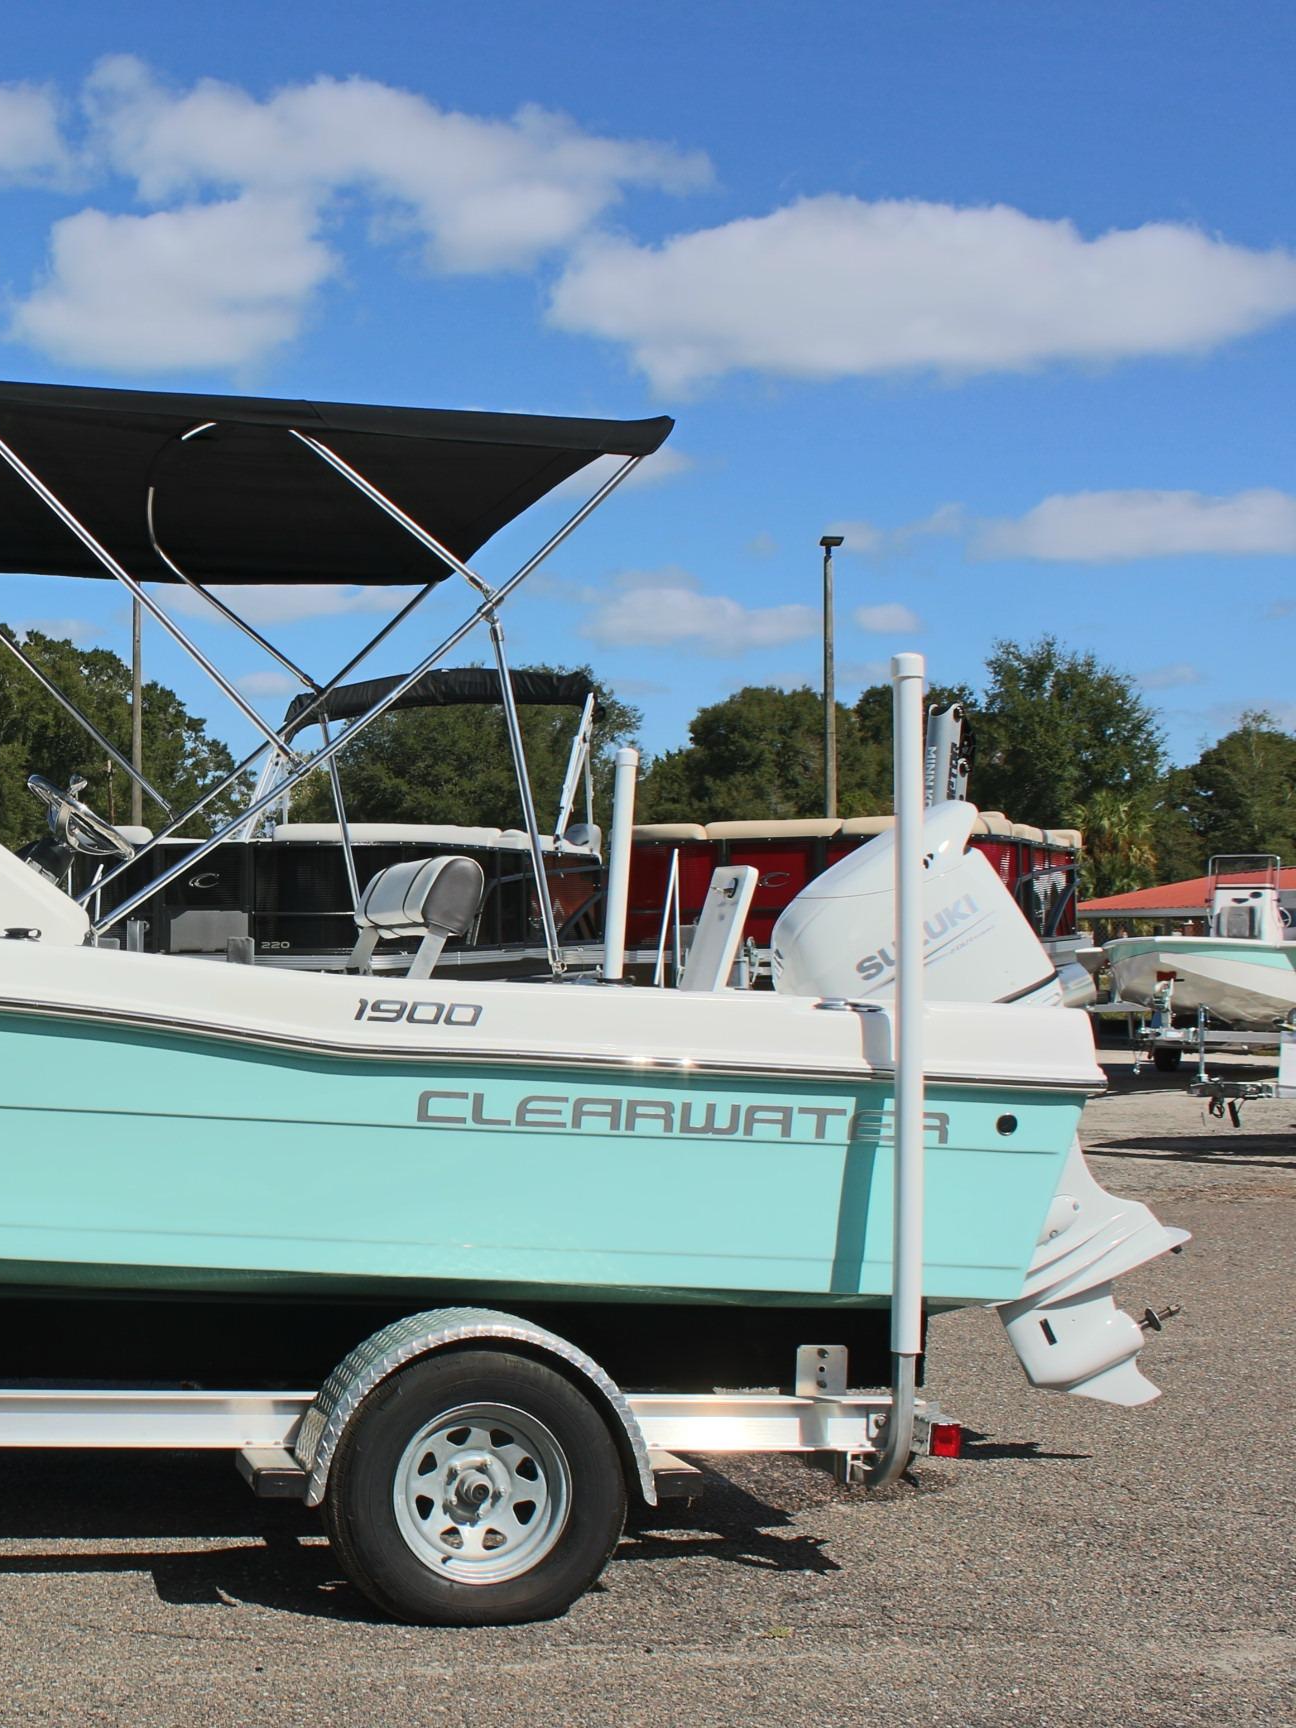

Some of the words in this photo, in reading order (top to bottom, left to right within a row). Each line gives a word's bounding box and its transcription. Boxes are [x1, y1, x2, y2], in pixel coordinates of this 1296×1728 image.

[926, 745, 937, 789] MINN
[260, 941, 290, 949] 220
[855, 893, 980, 981] SUUKI
[354, 998, 483, 1026] 1900
